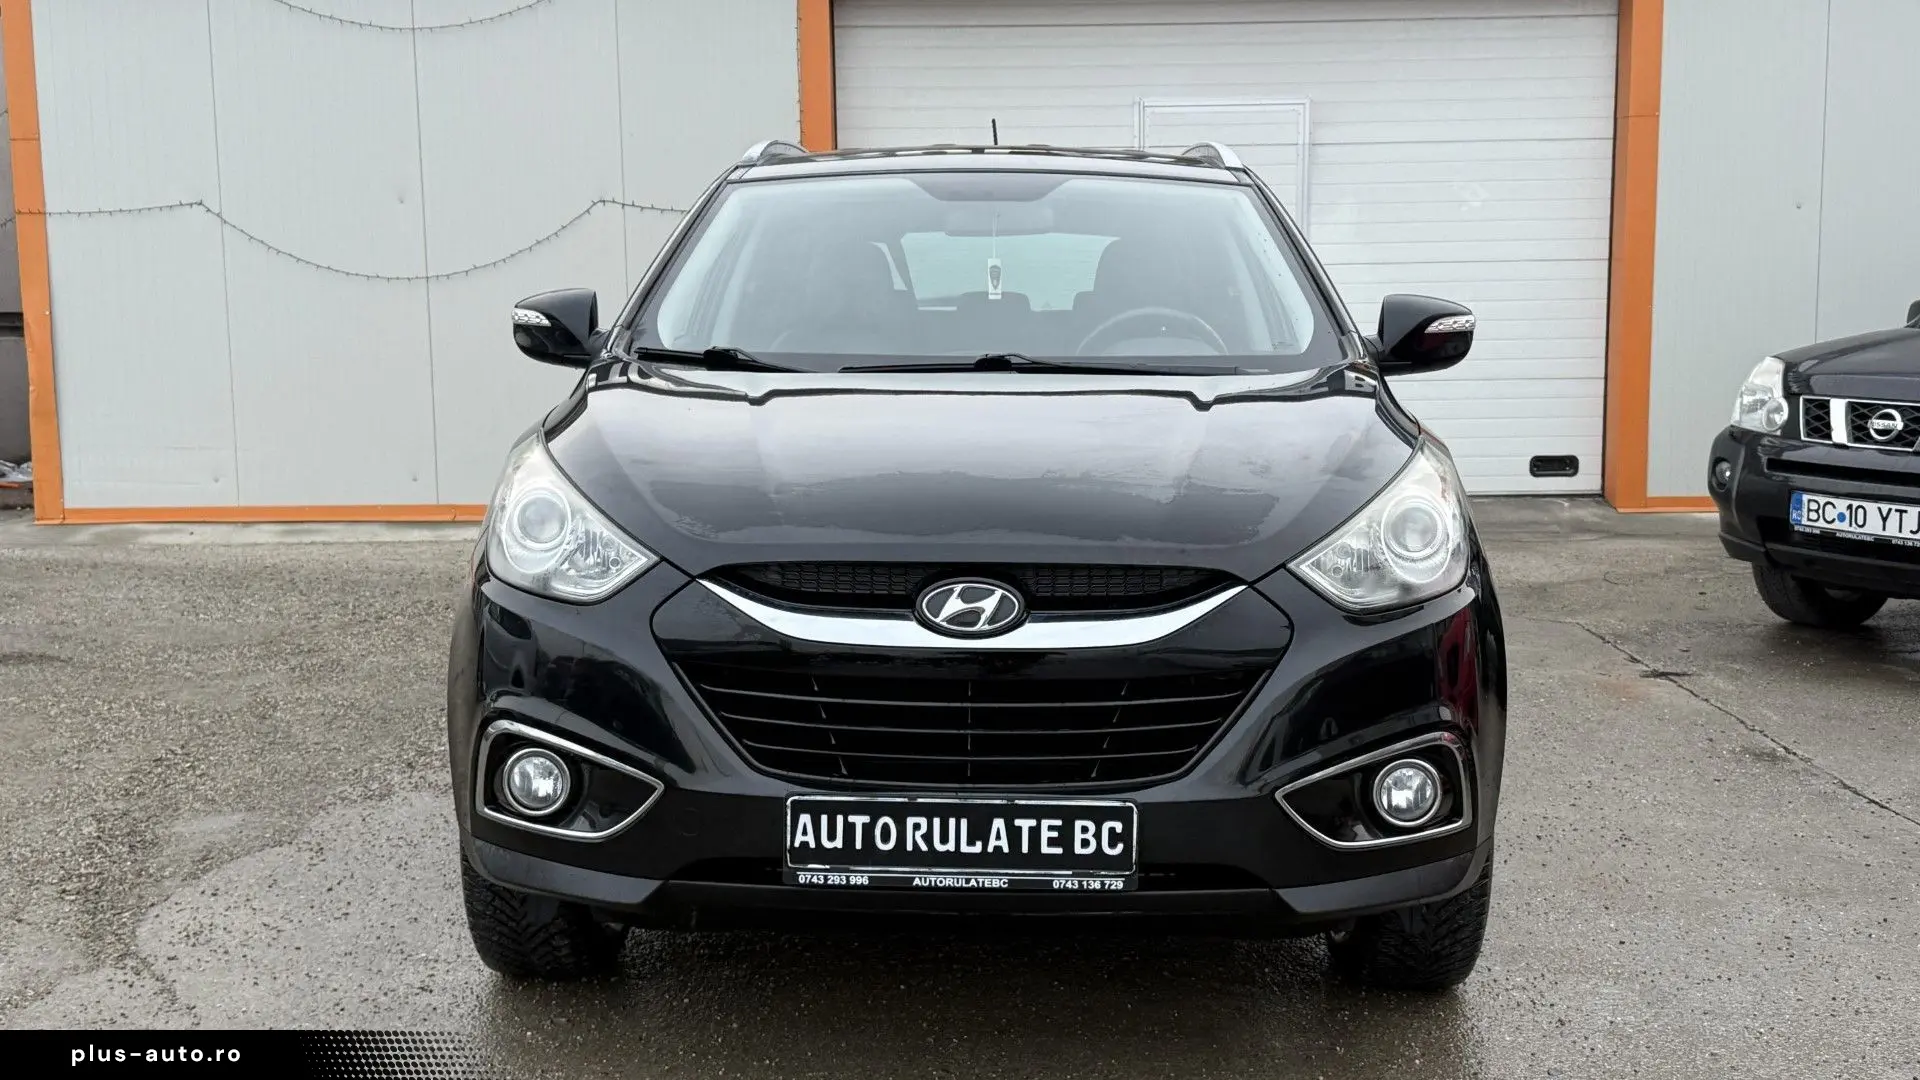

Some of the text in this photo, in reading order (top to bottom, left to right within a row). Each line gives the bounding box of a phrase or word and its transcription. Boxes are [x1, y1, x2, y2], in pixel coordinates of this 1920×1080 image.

[1806, 498, 1837, 525] BC
[1846, 503, 1867, 529] 10
[793, 813, 1124, 856] AUTO RULATE BC
[798, 874, 869, 886] 0743 293 996
[912, 877, 1009, 889] AUTORULATEBC
[1052, 879, 1124, 891] 0743 136 729
